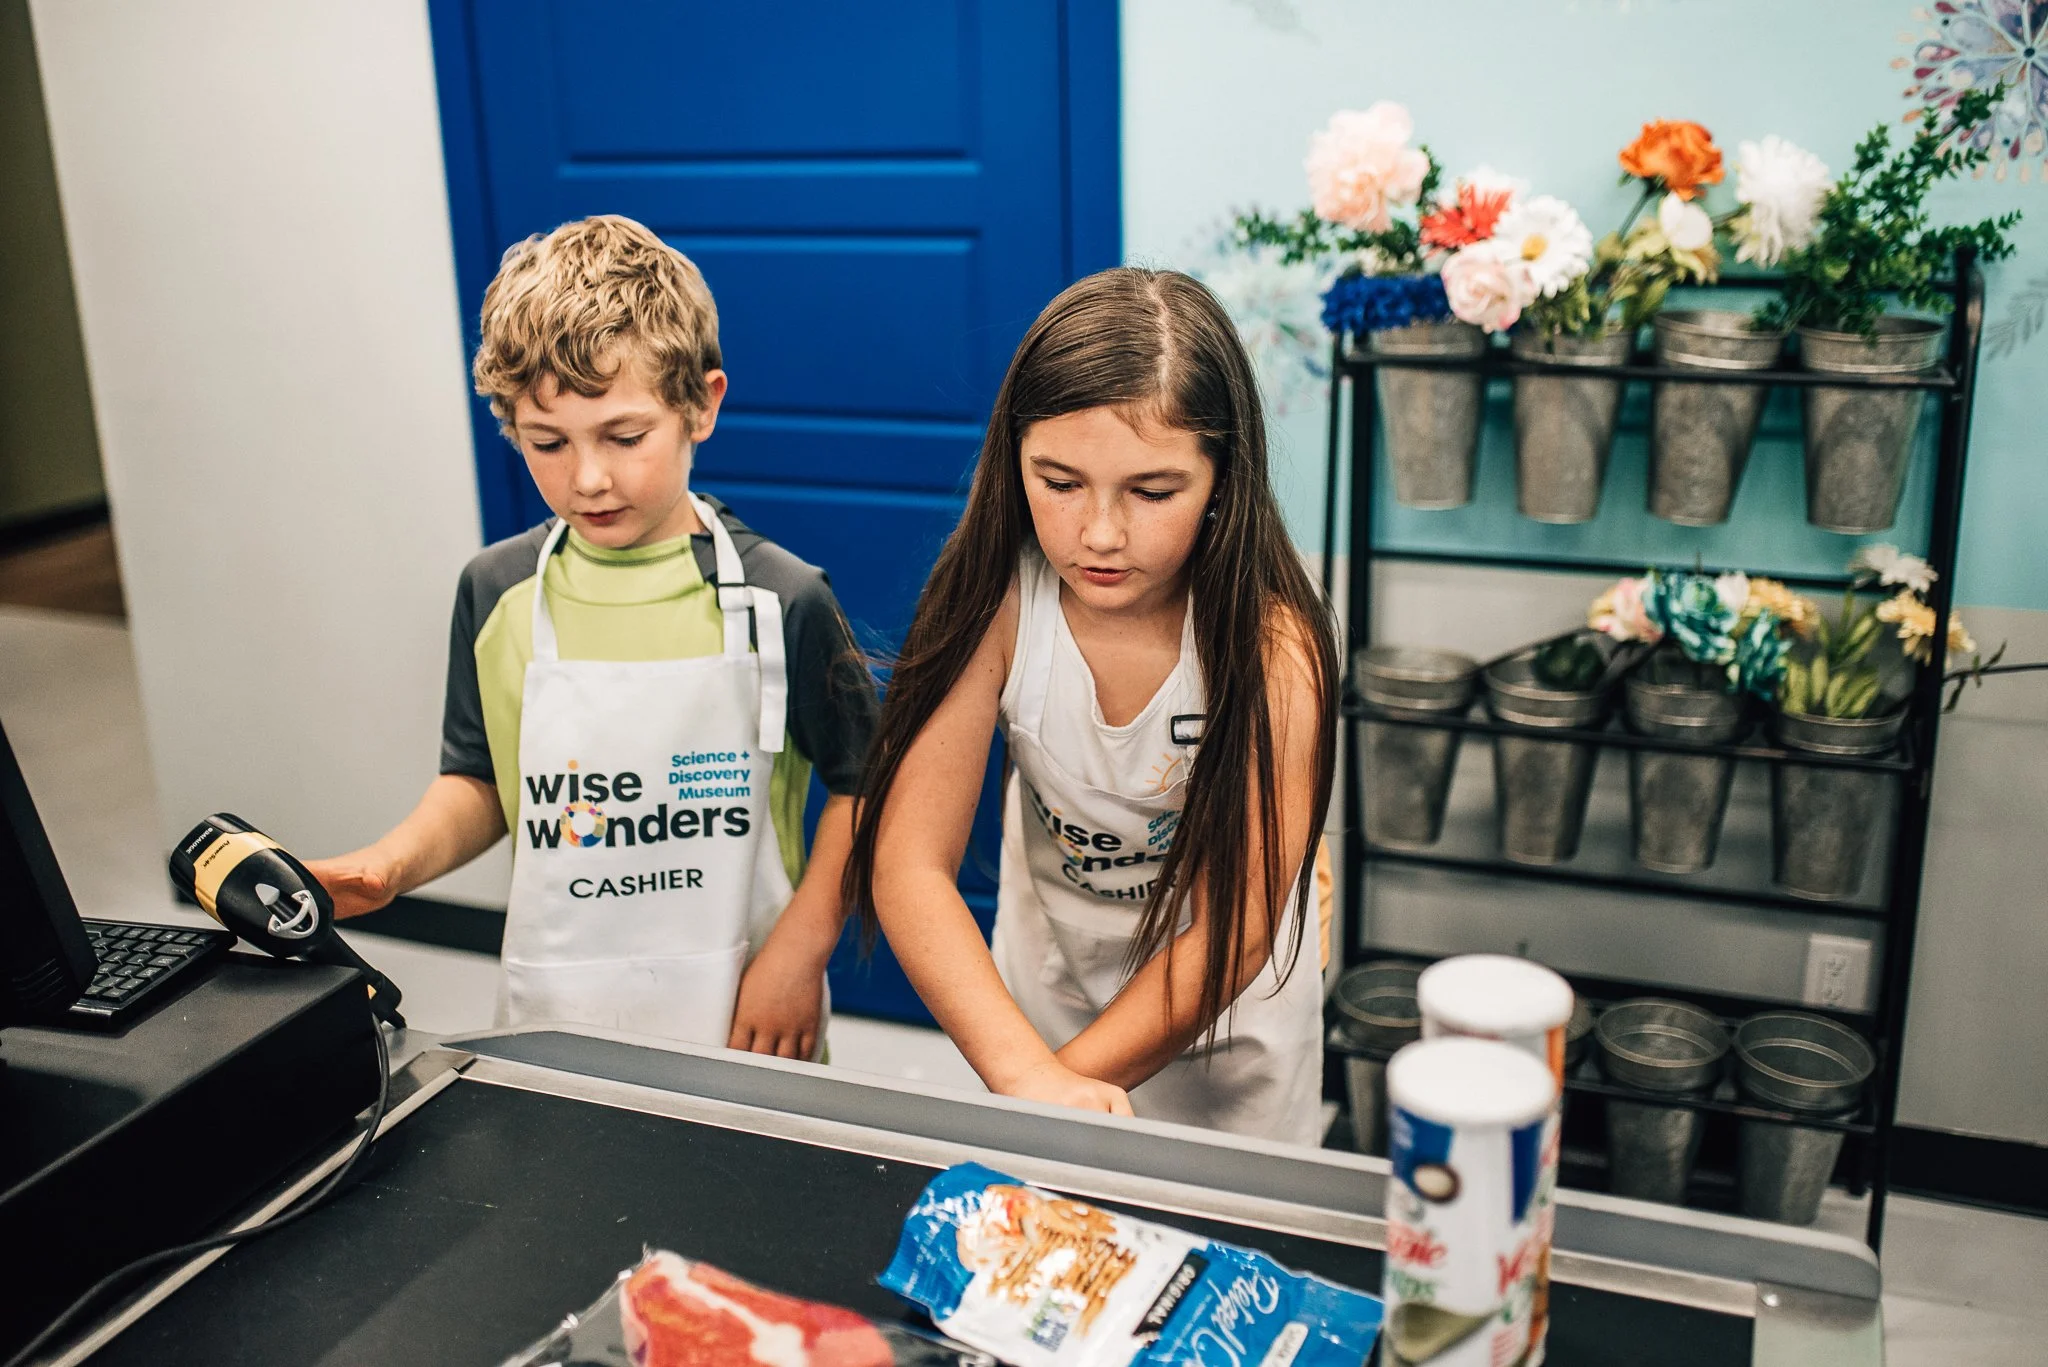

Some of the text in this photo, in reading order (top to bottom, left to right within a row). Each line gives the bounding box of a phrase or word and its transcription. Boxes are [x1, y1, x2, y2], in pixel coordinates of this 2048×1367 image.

[668, 768, 751, 785] Discovery
[671, 750, 750, 767] Science +
[526, 759, 643, 805] wise
[678, 786, 751, 800] Museum
[526, 801, 751, 850] wonders
[569, 869, 704, 899] CASHIER
[1147, 1264, 1196, 1325] ORIGINAL
[1207, 1271, 1280, 1356] Pretzel
